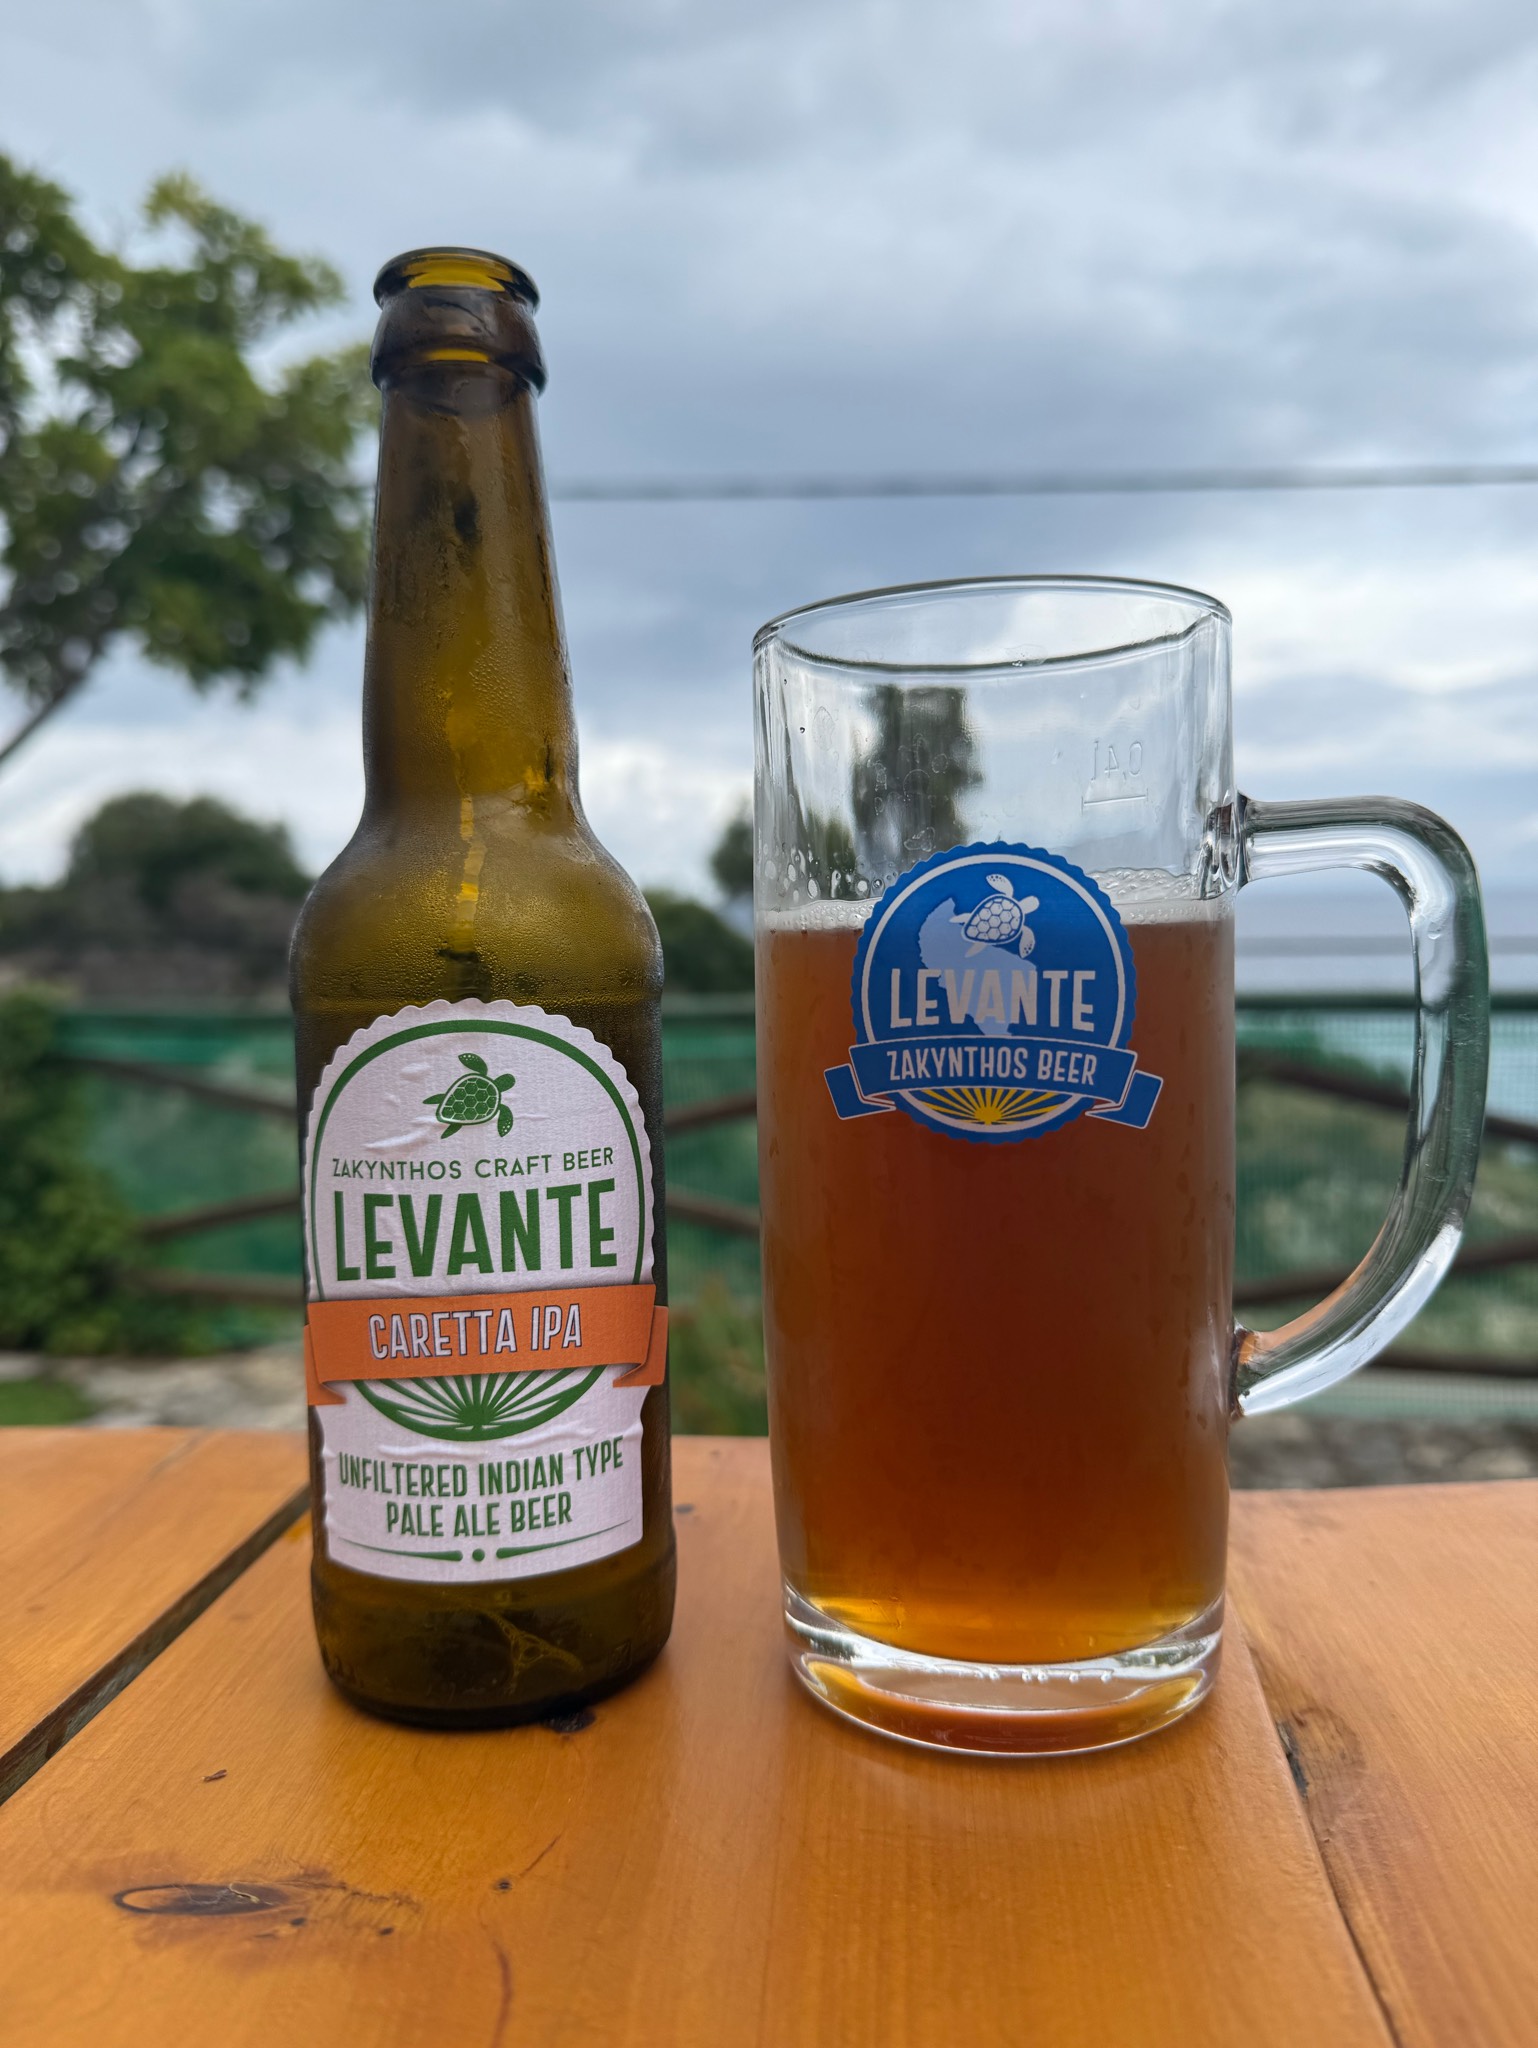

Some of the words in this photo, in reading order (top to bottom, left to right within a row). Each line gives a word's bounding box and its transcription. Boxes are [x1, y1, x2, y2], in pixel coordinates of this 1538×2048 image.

[890, 968, 1096, 1032] LEVANTE
[886, 1046, 1029, 1081] ZAKYNTHOS
[1037, 1050, 1098, 1086] BEER
[332, 1158, 462, 1180] ZAKYNTHOS
[474, 1154, 551, 1178] CRAFT
[563, 1147, 614, 1172] BEER
[334, 1178, 617, 1282] LEVANTE
[368, 1308, 517, 1360] CARETTA
[531, 1303, 583, 1350] IPA
[338, 1451, 468, 1497] UNFILTERED
[478, 1451, 565, 1496] INDIAN
[571, 1435, 624, 1481] TYPE
[386, 1501, 444, 1537] PALE
[453, 1501, 501, 1537] ALE
[510, 1491, 573, 1533] BEER
